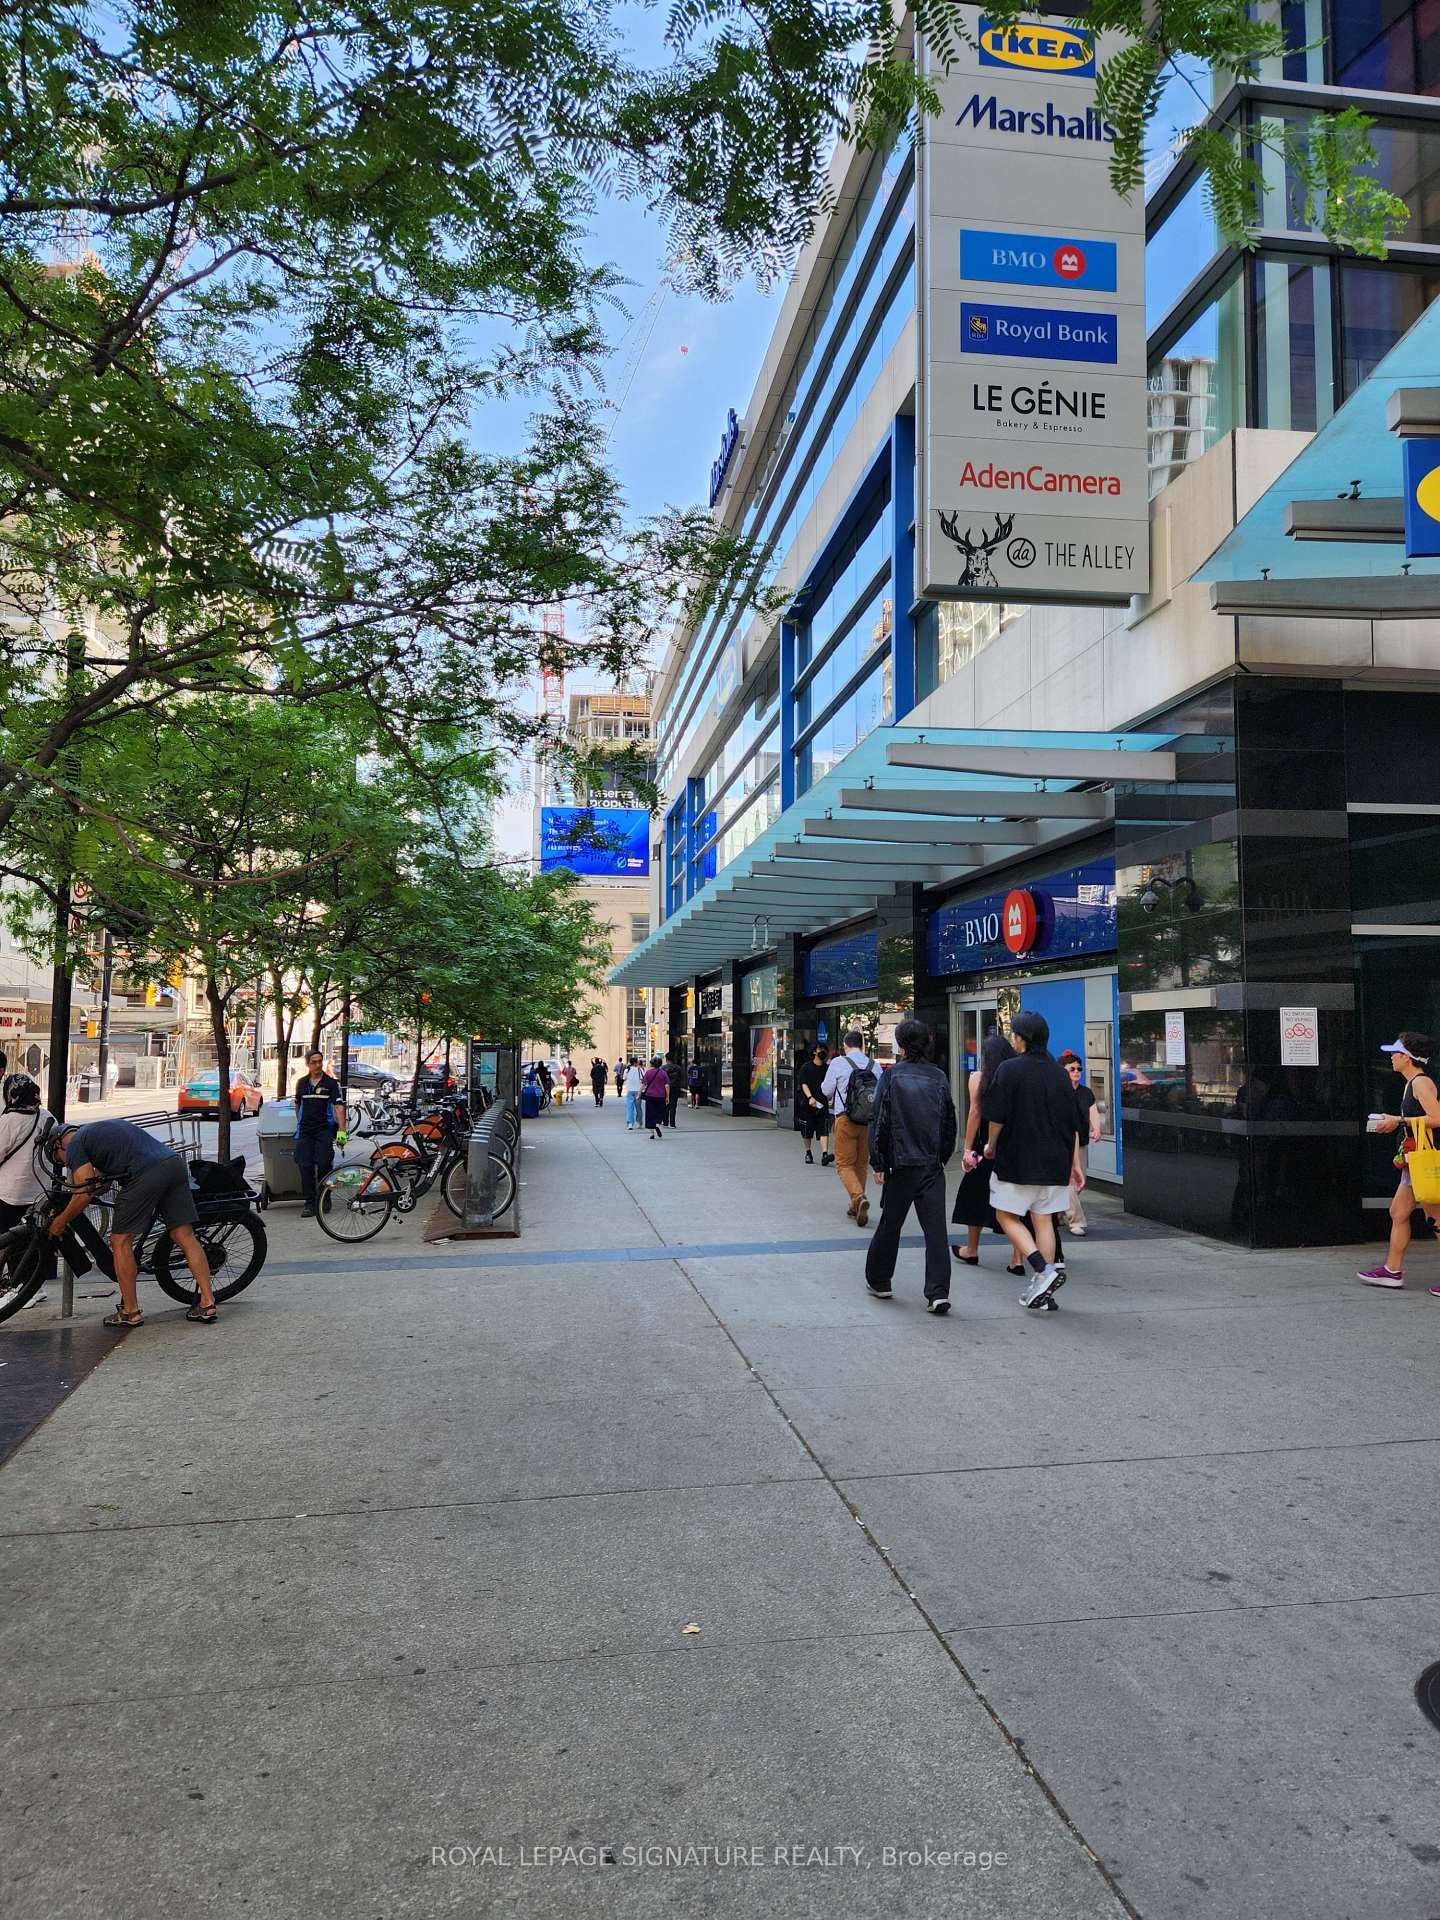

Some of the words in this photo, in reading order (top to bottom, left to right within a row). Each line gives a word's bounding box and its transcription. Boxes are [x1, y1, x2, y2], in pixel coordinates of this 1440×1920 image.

[991, 32, 1088, 61] IKEA
[955, 94, 1118, 142] Marshalls
[992, 248, 1047, 269] BMO
[996, 319, 1051, 343] Royal
[1058, 324, 1109, 345] Bank
[973, 383, 1002, 412] LE
[1011, 380, 1106, 419] GÉNIE
[996, 418, 1029, 431] Bakery
[1032, 421, 1040, 430] &
[1043, 423, 1084, 433] Espresso
[959, 461, 1121, 496] AdenCamera
[1044, 542, 1077, 567] THE
[1082, 543, 1135, 570] ALLEY
[964, 912, 999, 947] BMO
